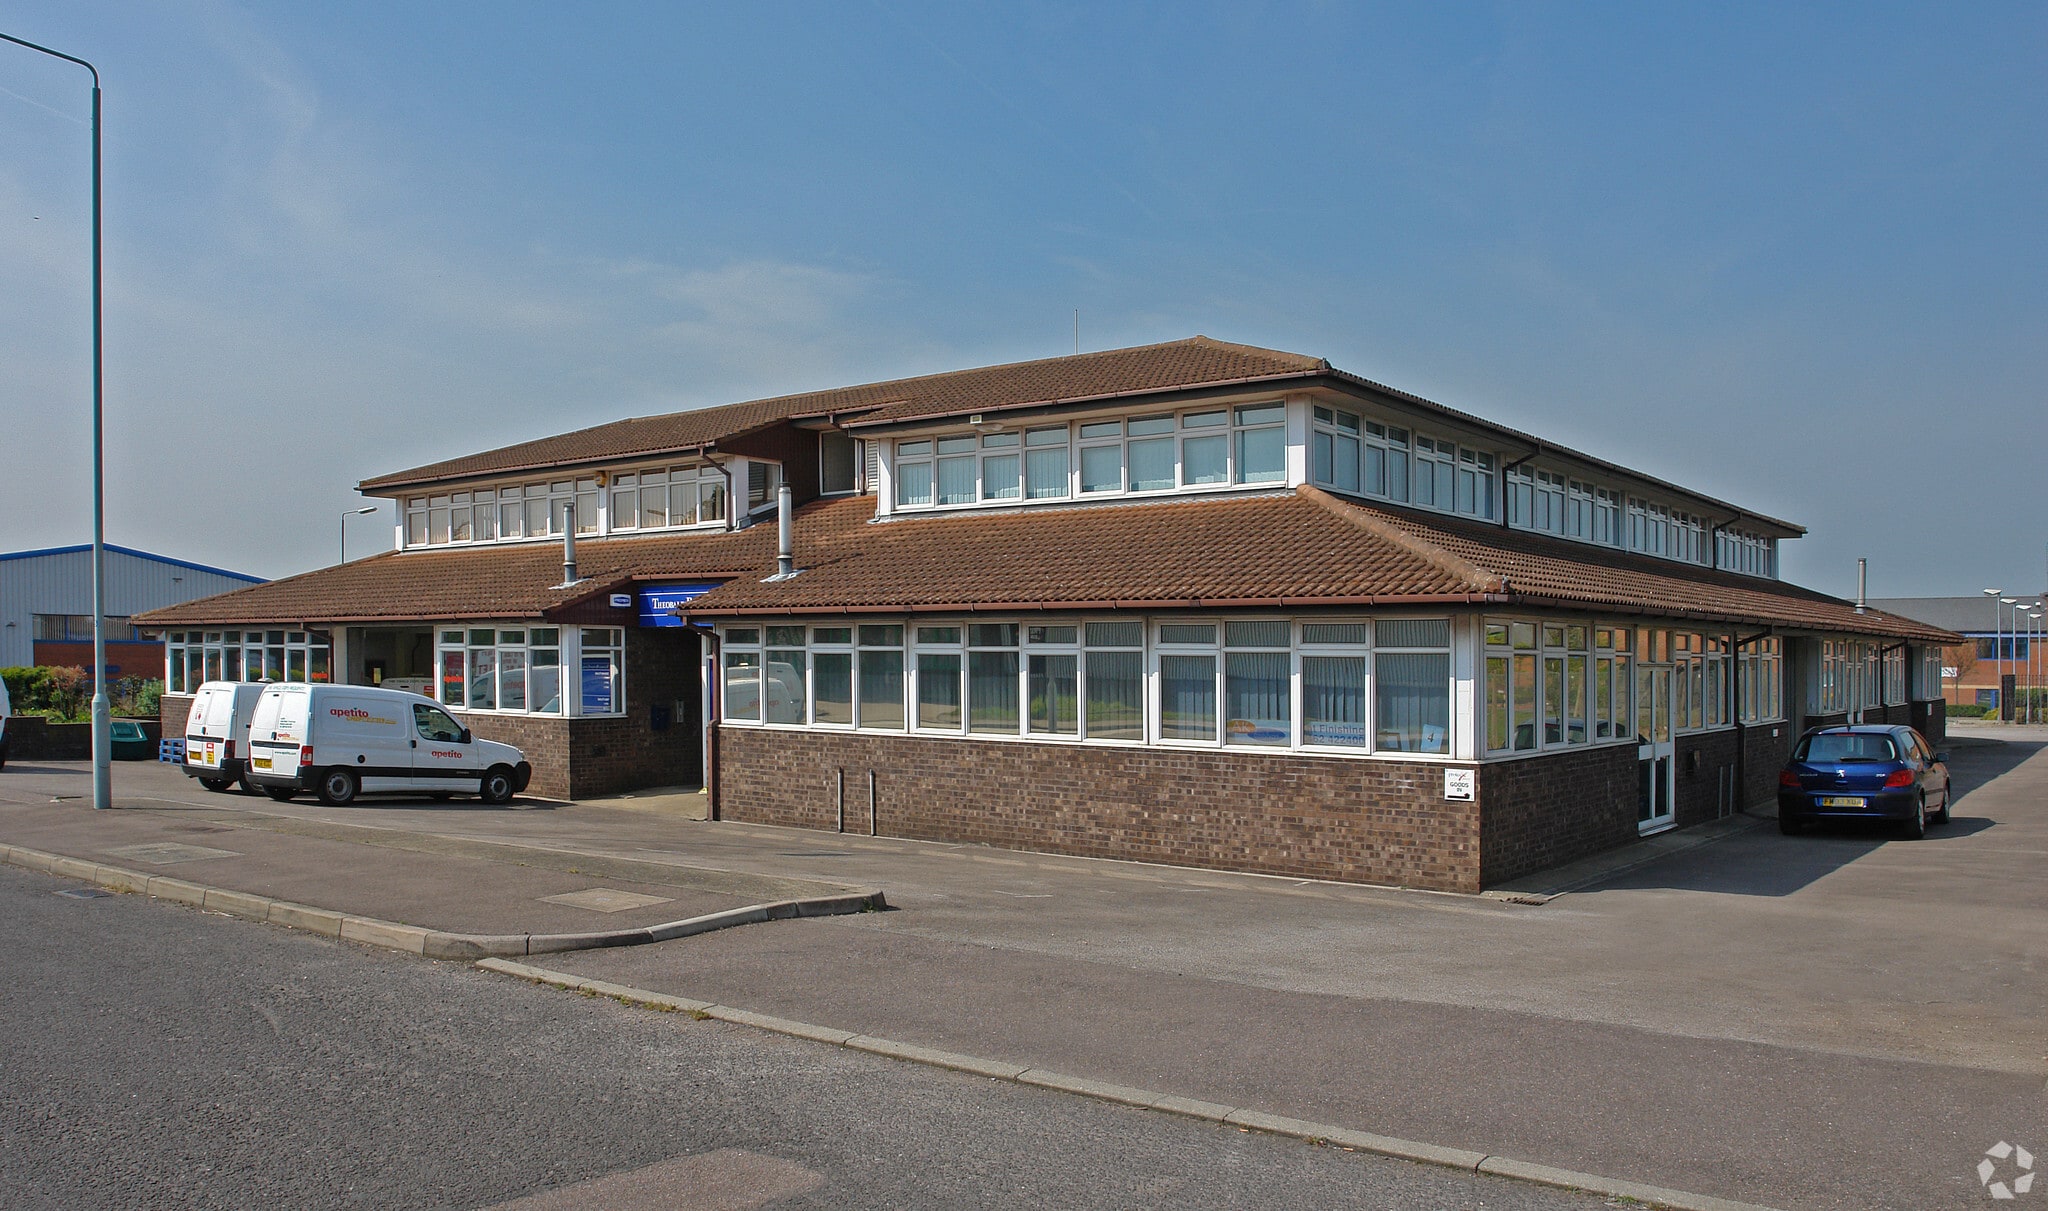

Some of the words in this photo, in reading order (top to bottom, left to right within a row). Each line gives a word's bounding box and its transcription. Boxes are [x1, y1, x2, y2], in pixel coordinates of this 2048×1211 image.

[652, 598, 685, 609] THEOBAL
[330, 707, 369, 718] apetito
[1427, 732, 1434, 743] 4
[431, 749, 463, 759] apetito
